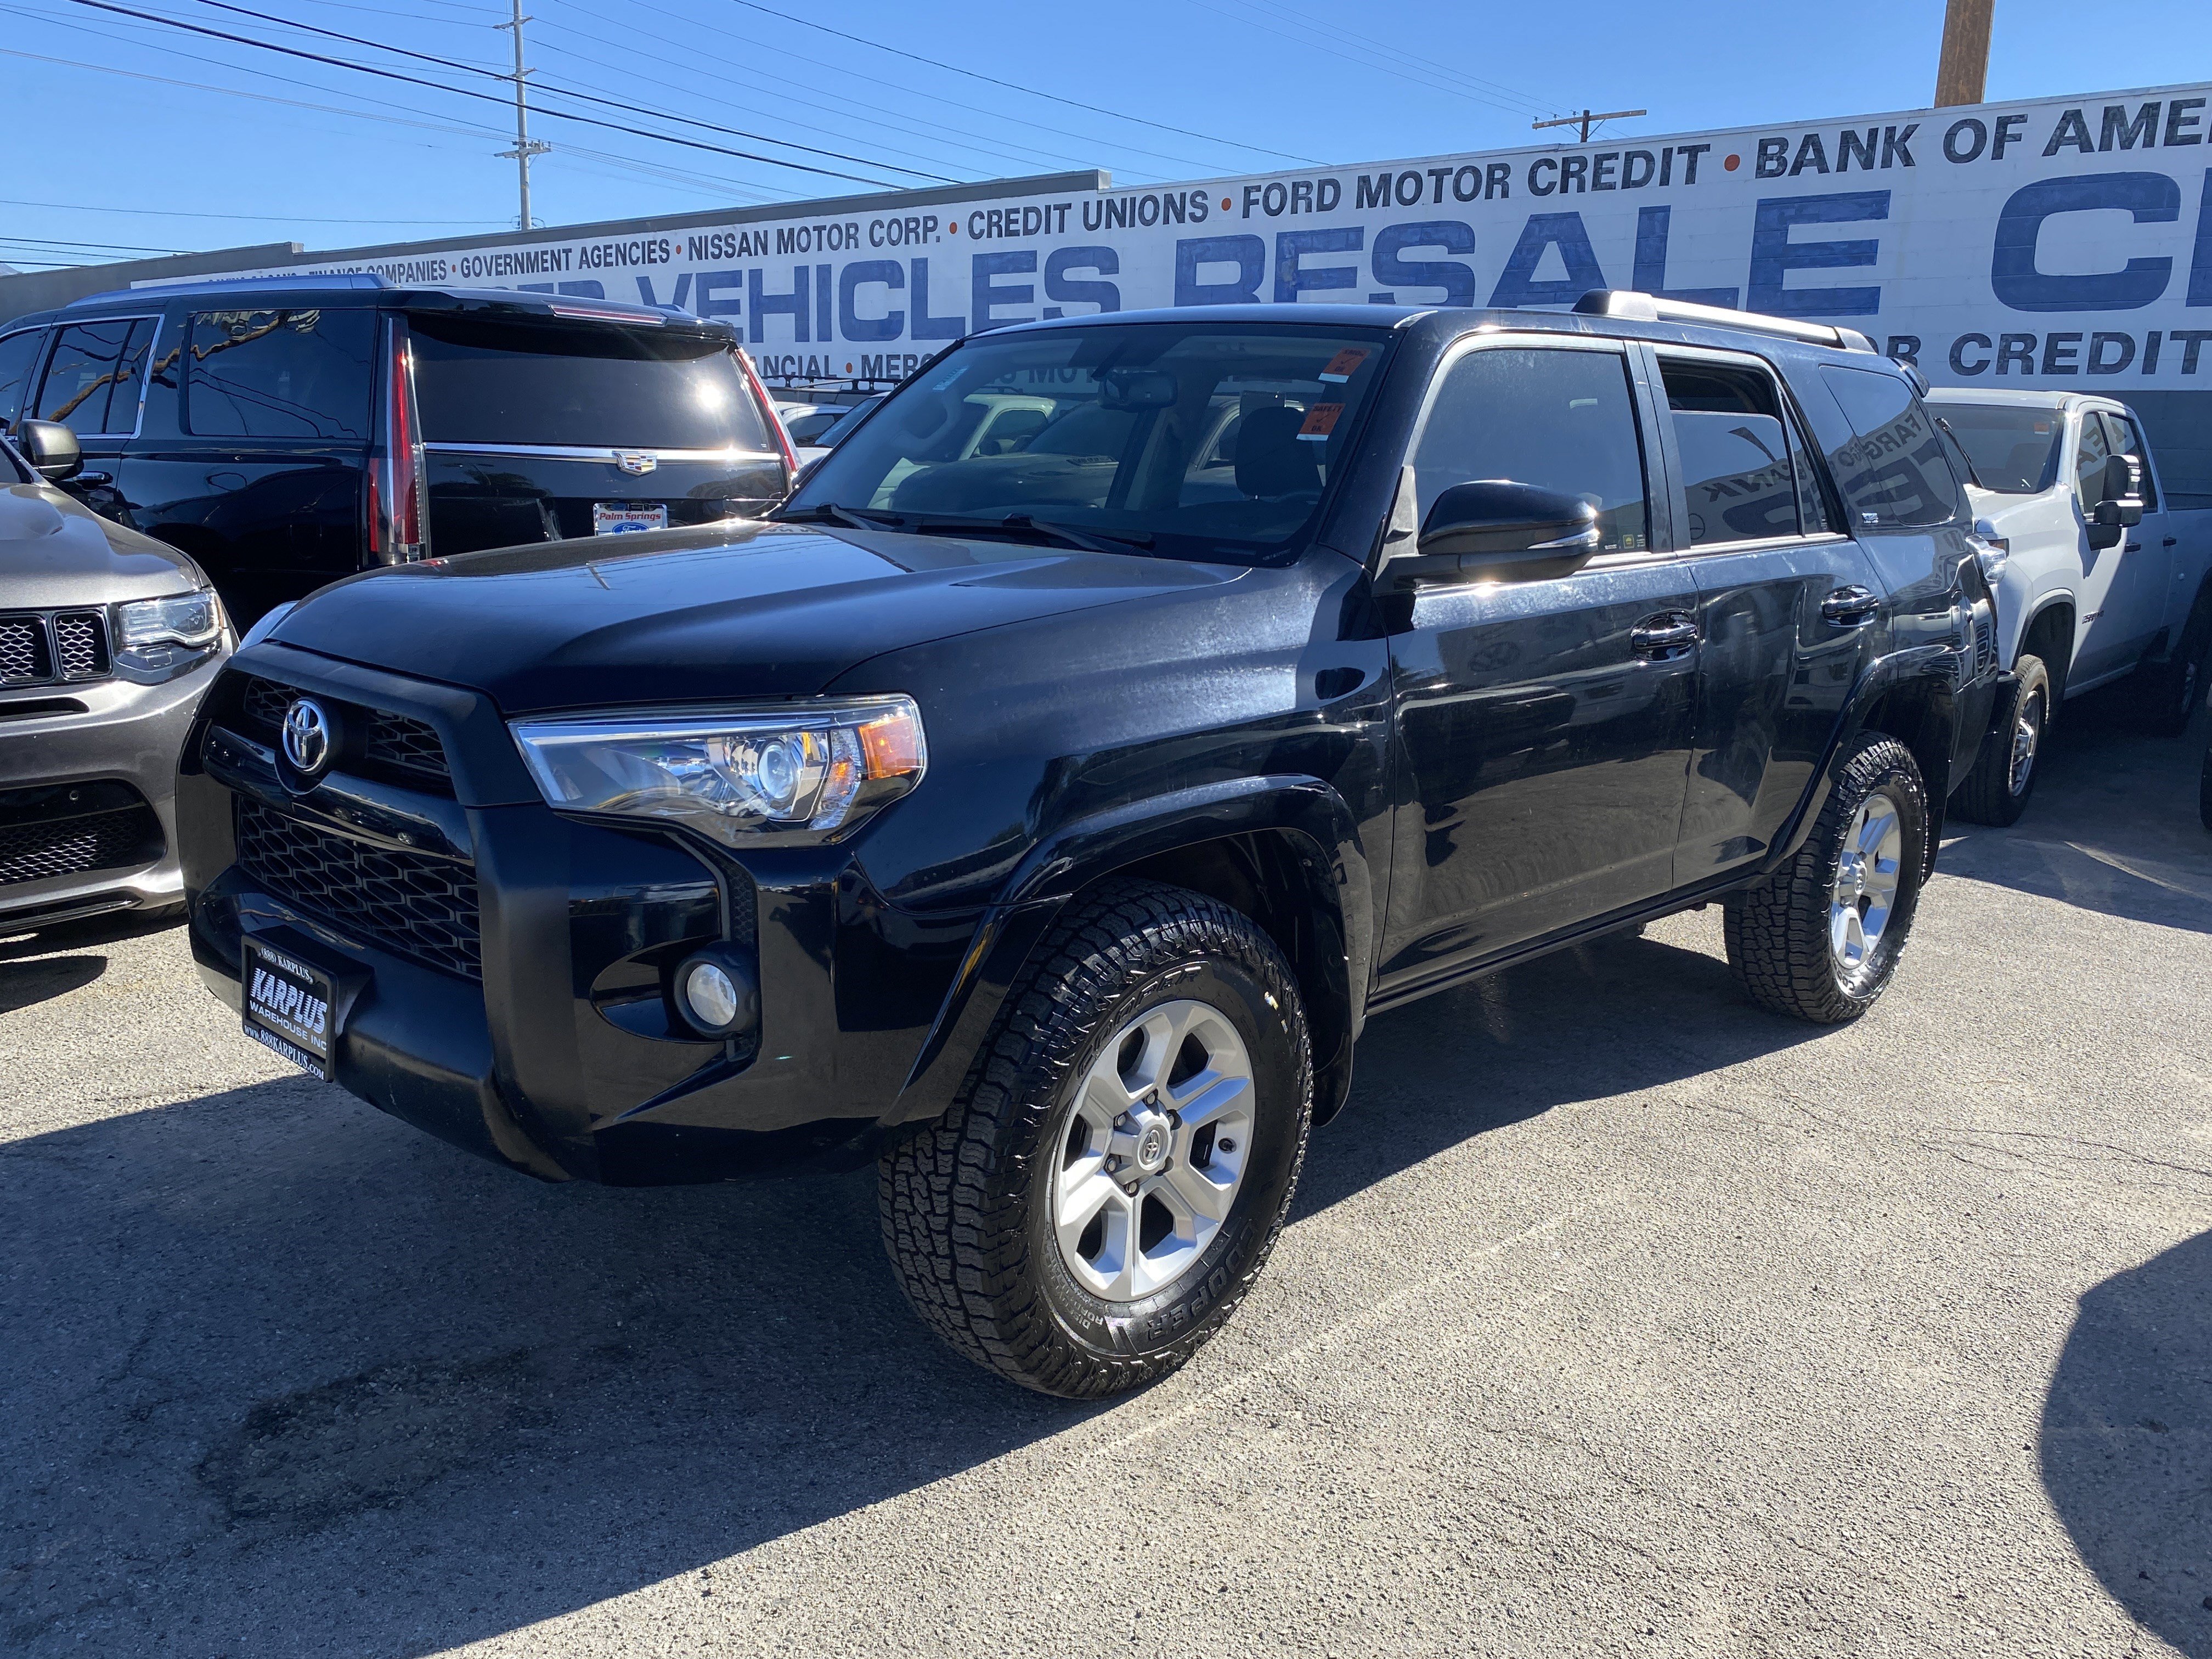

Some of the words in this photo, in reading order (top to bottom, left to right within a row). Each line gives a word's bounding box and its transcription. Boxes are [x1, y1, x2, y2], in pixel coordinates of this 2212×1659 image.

[461, 248, 572, 278] GOVERNMENT
[578, 238, 670, 269] AGENCIES
[689, 230, 768, 261] NISSAN
[777, 222, 859, 255] MOTOR
[870, 215, 940, 248] CORP.
[968, 202, 1072, 240] CREDIT
[1082, 190, 1209, 231] UNIONS
[1242, 178, 1341, 218] FORD
[1356, 162, 1510, 209] MOTOR
[1528, 143, 1711, 196] CREDIT
[1756, 123, 1921, 179] BANK
[1943, 114, 2028, 163] OF
[2041, 97, 2212, 157] AME
[635, 245, 1121, 342] VEHICLES
[1173, 190, 1892, 318] RESALE
[1991, 167, 2212, 312] C
[1864, 335, 1921, 369] R
[1949, 330, 2212, 376] CREDIT
[599, 512, 623, 520] Palm
[625, 512, 661, 521] Springs
[261, 947, 277, 963] (888)
[250, 967, 328, 1035] KARPLUS
[250, 1000, 308, 1041] WAREHOUSE
[311, 1034, 327, 1051] INC
